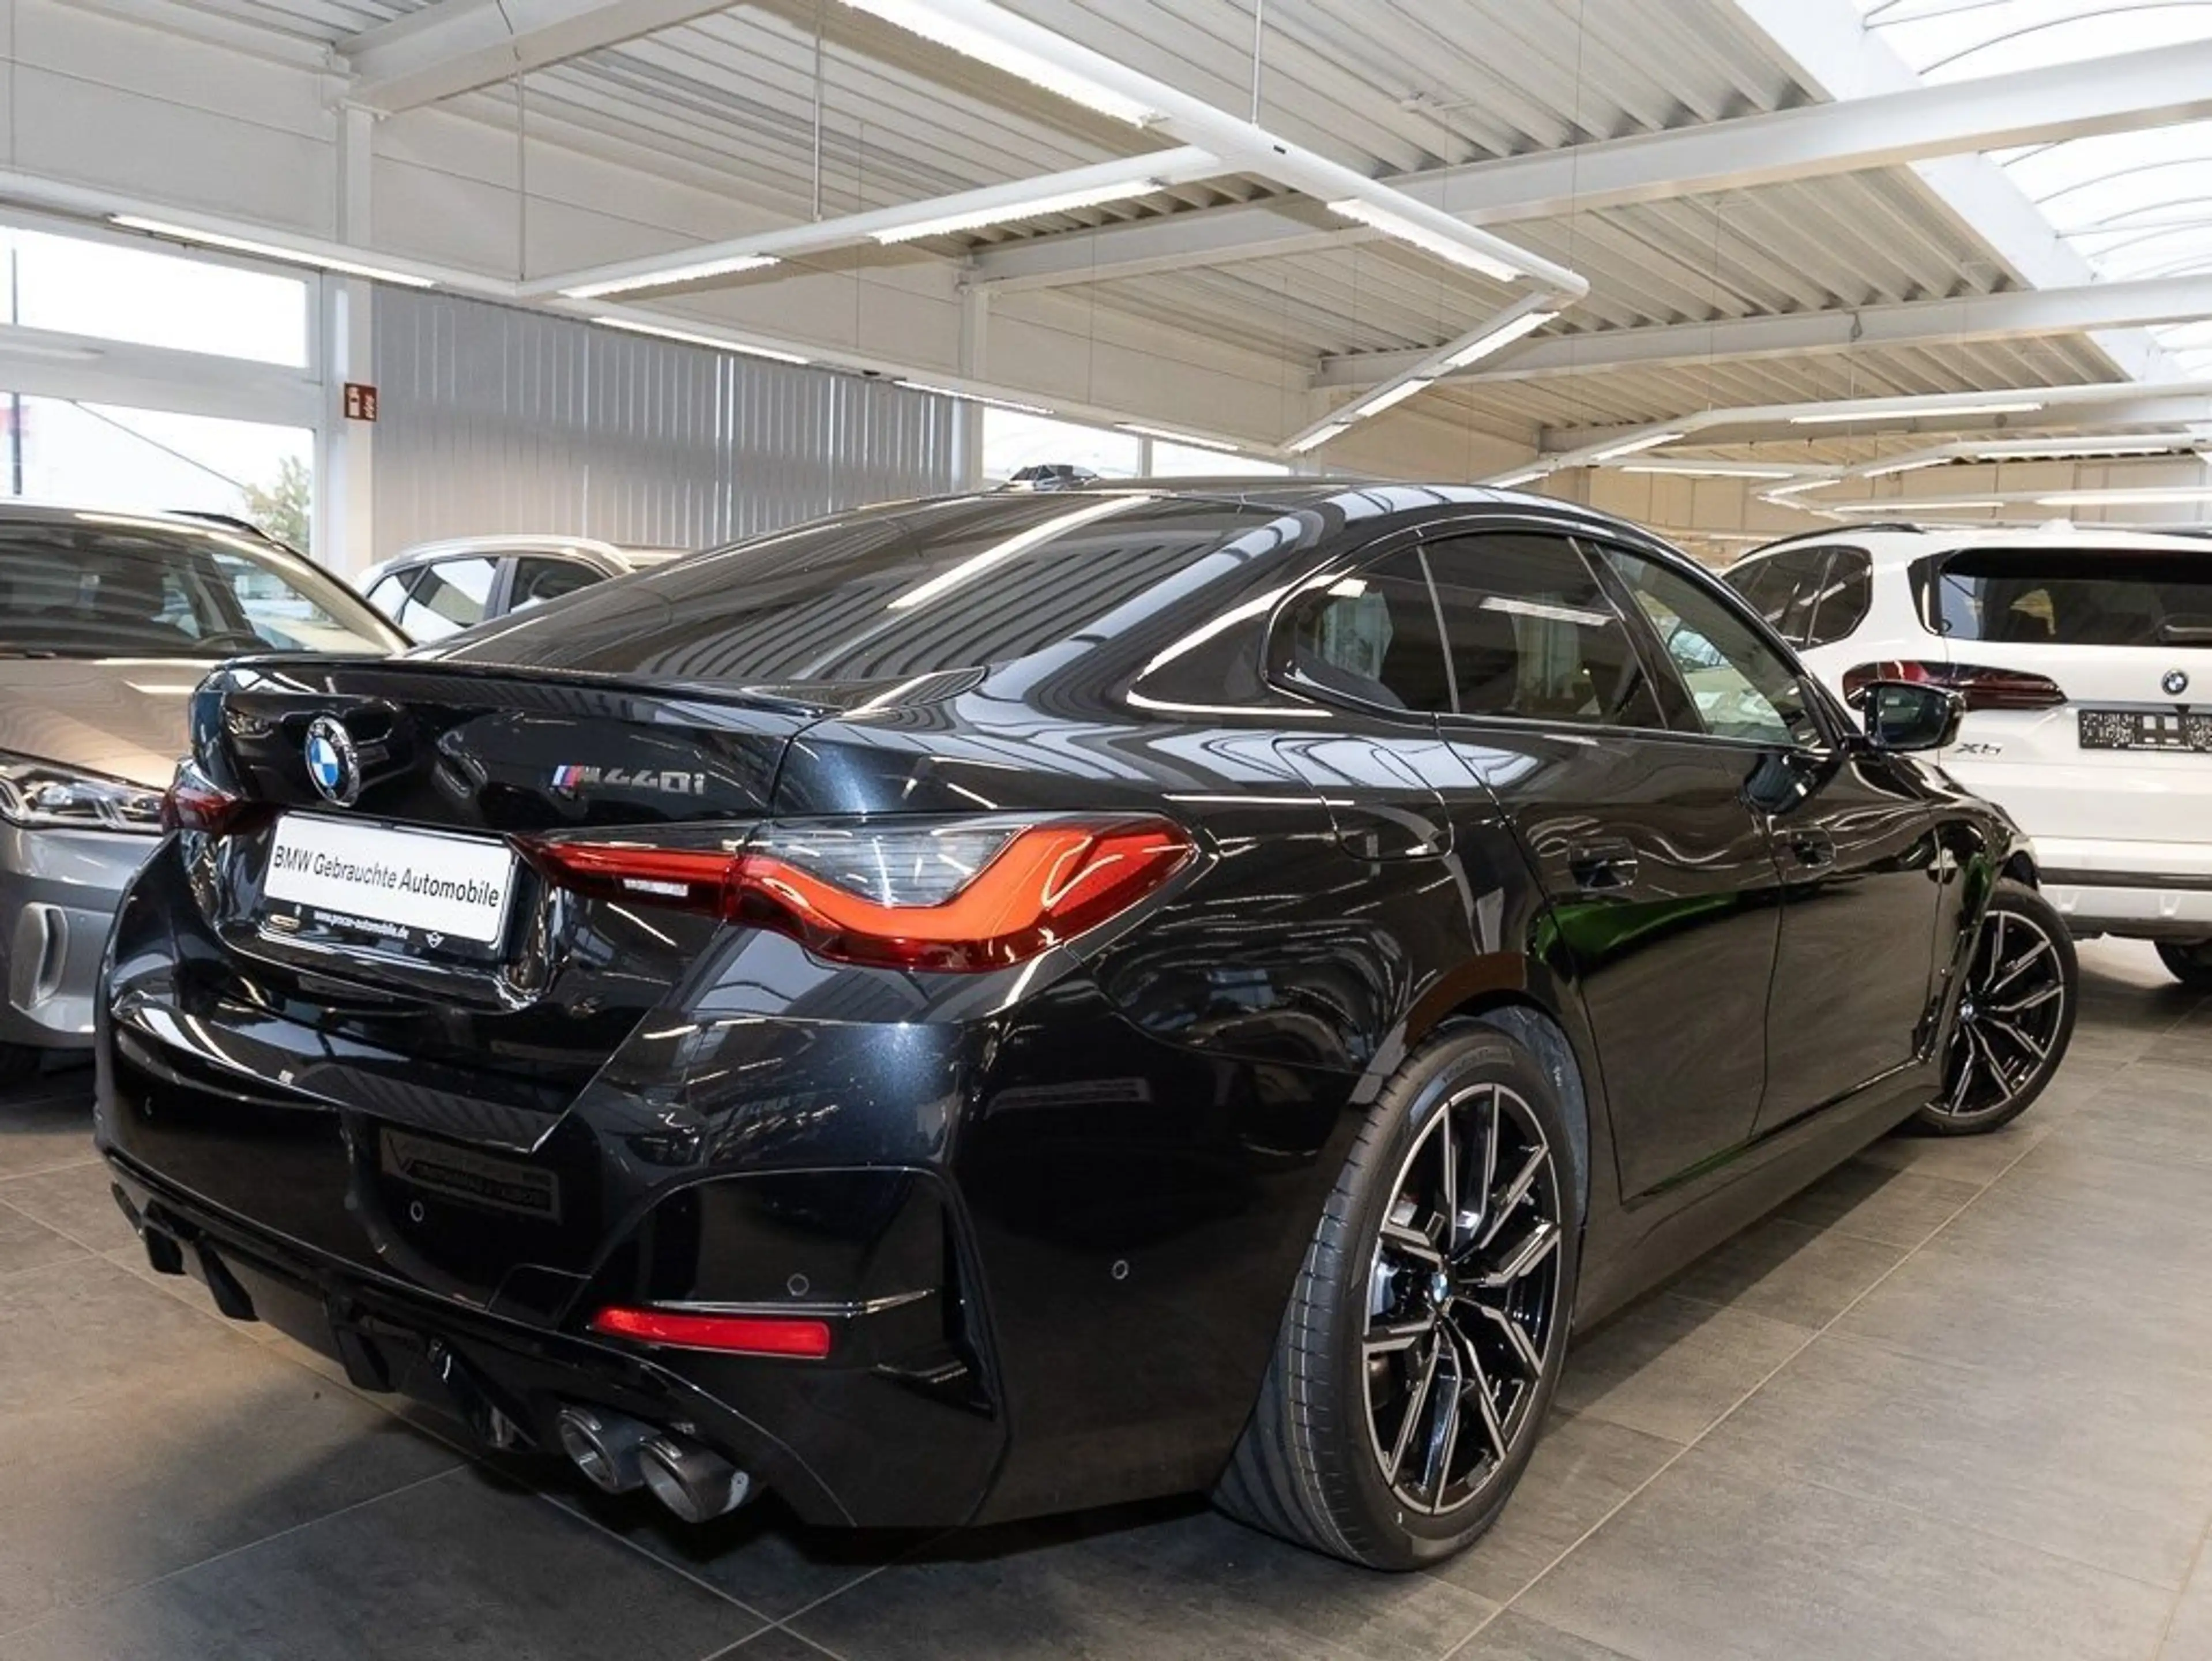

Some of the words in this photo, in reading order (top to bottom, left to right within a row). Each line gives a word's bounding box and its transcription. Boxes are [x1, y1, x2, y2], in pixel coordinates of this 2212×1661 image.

[273, 845, 313, 873] BMW
[313, 852, 397, 889] Gebrauchte
[397, 867, 499, 907] Automobile
